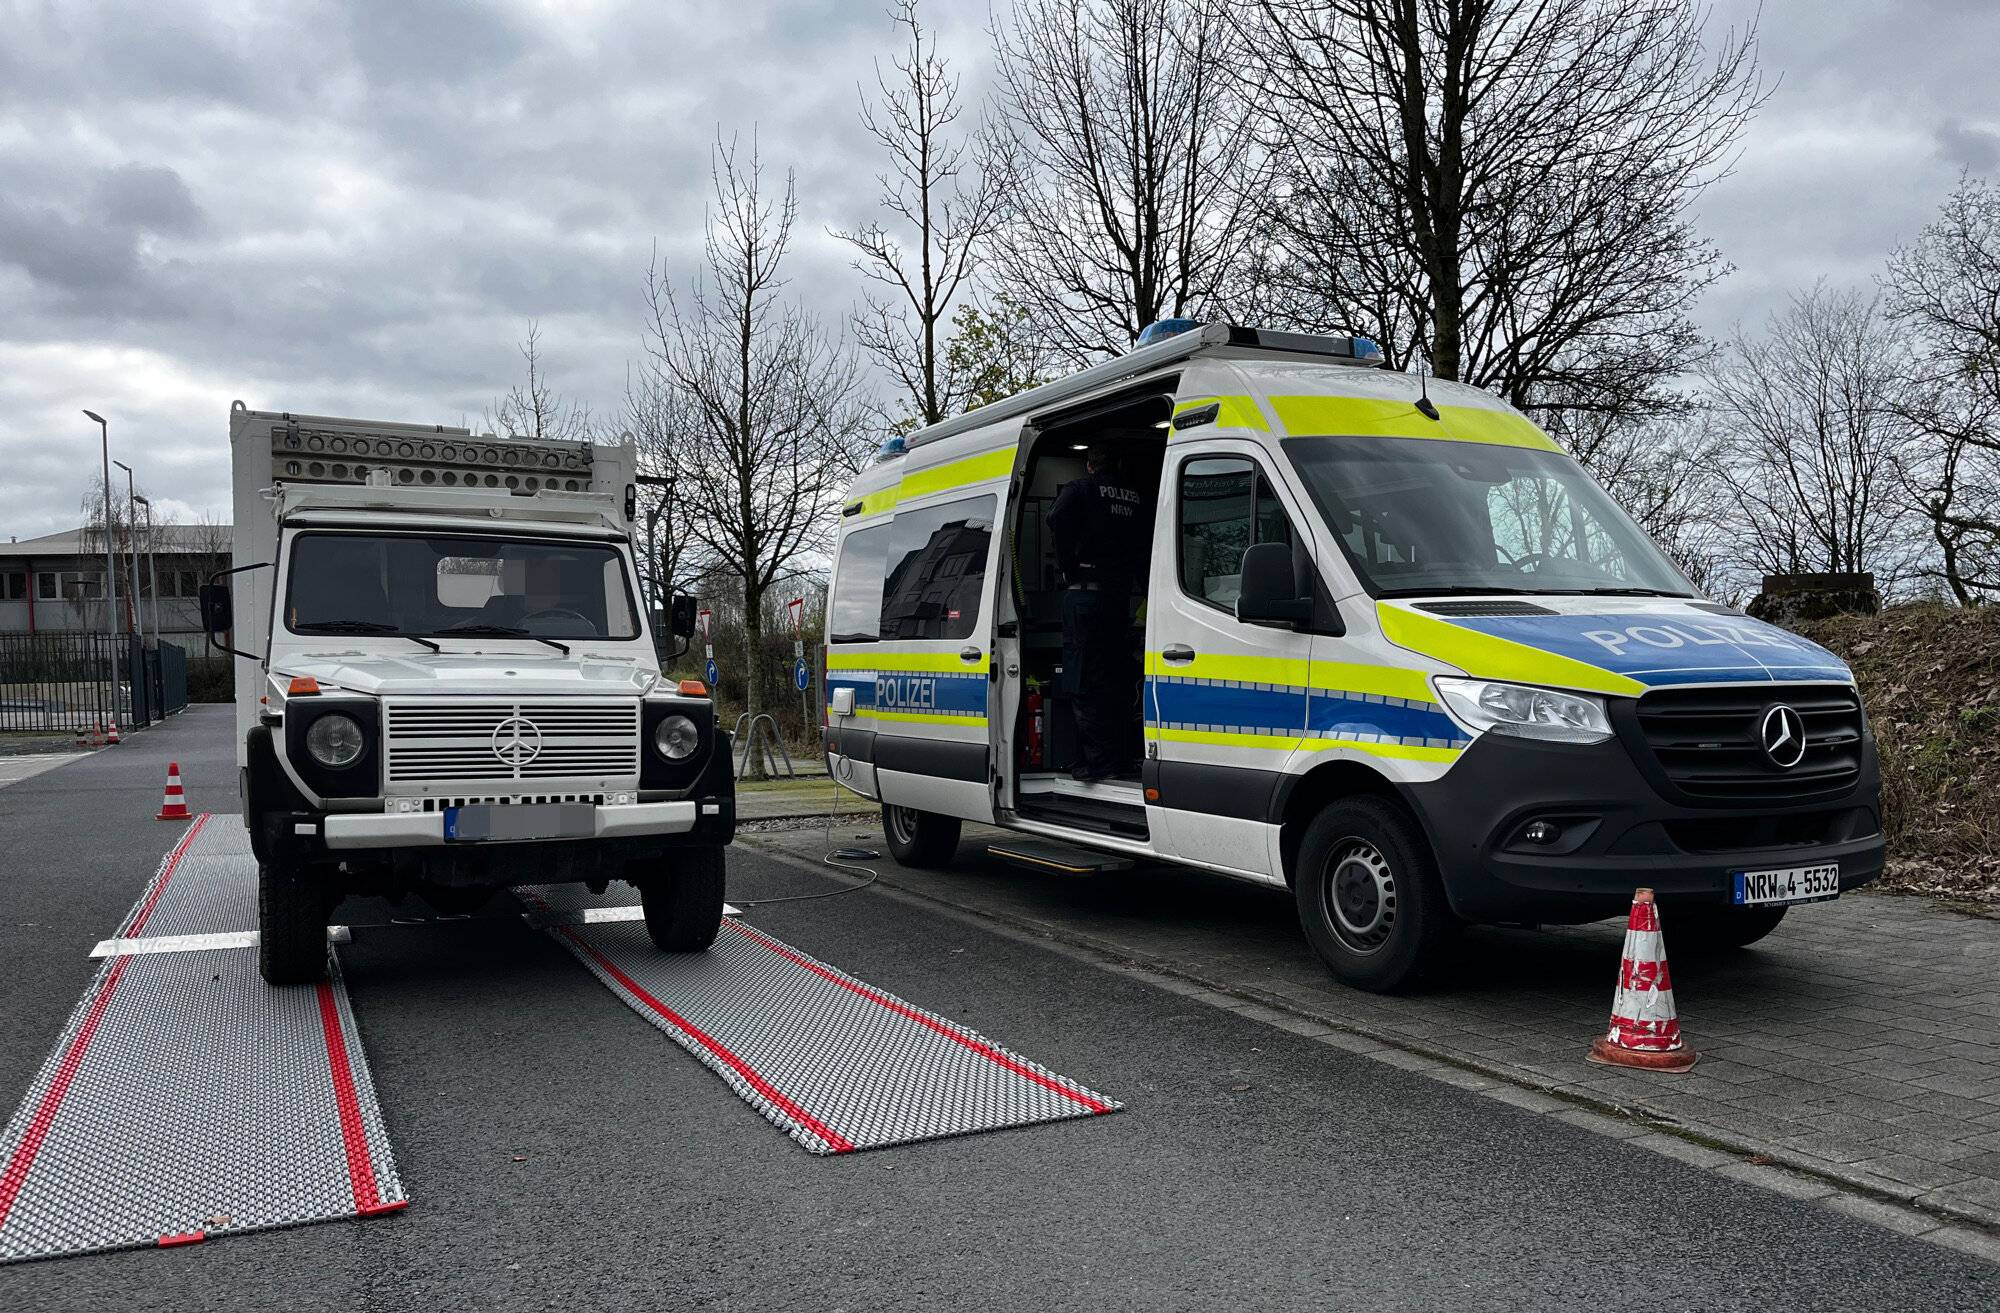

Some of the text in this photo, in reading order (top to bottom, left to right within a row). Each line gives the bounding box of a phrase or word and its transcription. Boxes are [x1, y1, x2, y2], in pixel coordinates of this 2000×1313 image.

[1099, 485, 1140, 504] POLIZEI
[1580, 624, 1812, 656] POLIZEI
[876, 678, 936, 708] POLIZEI
[1736, 891, 1742, 900] D
[1745, 867, 1838, 900] NRW 4-5532
